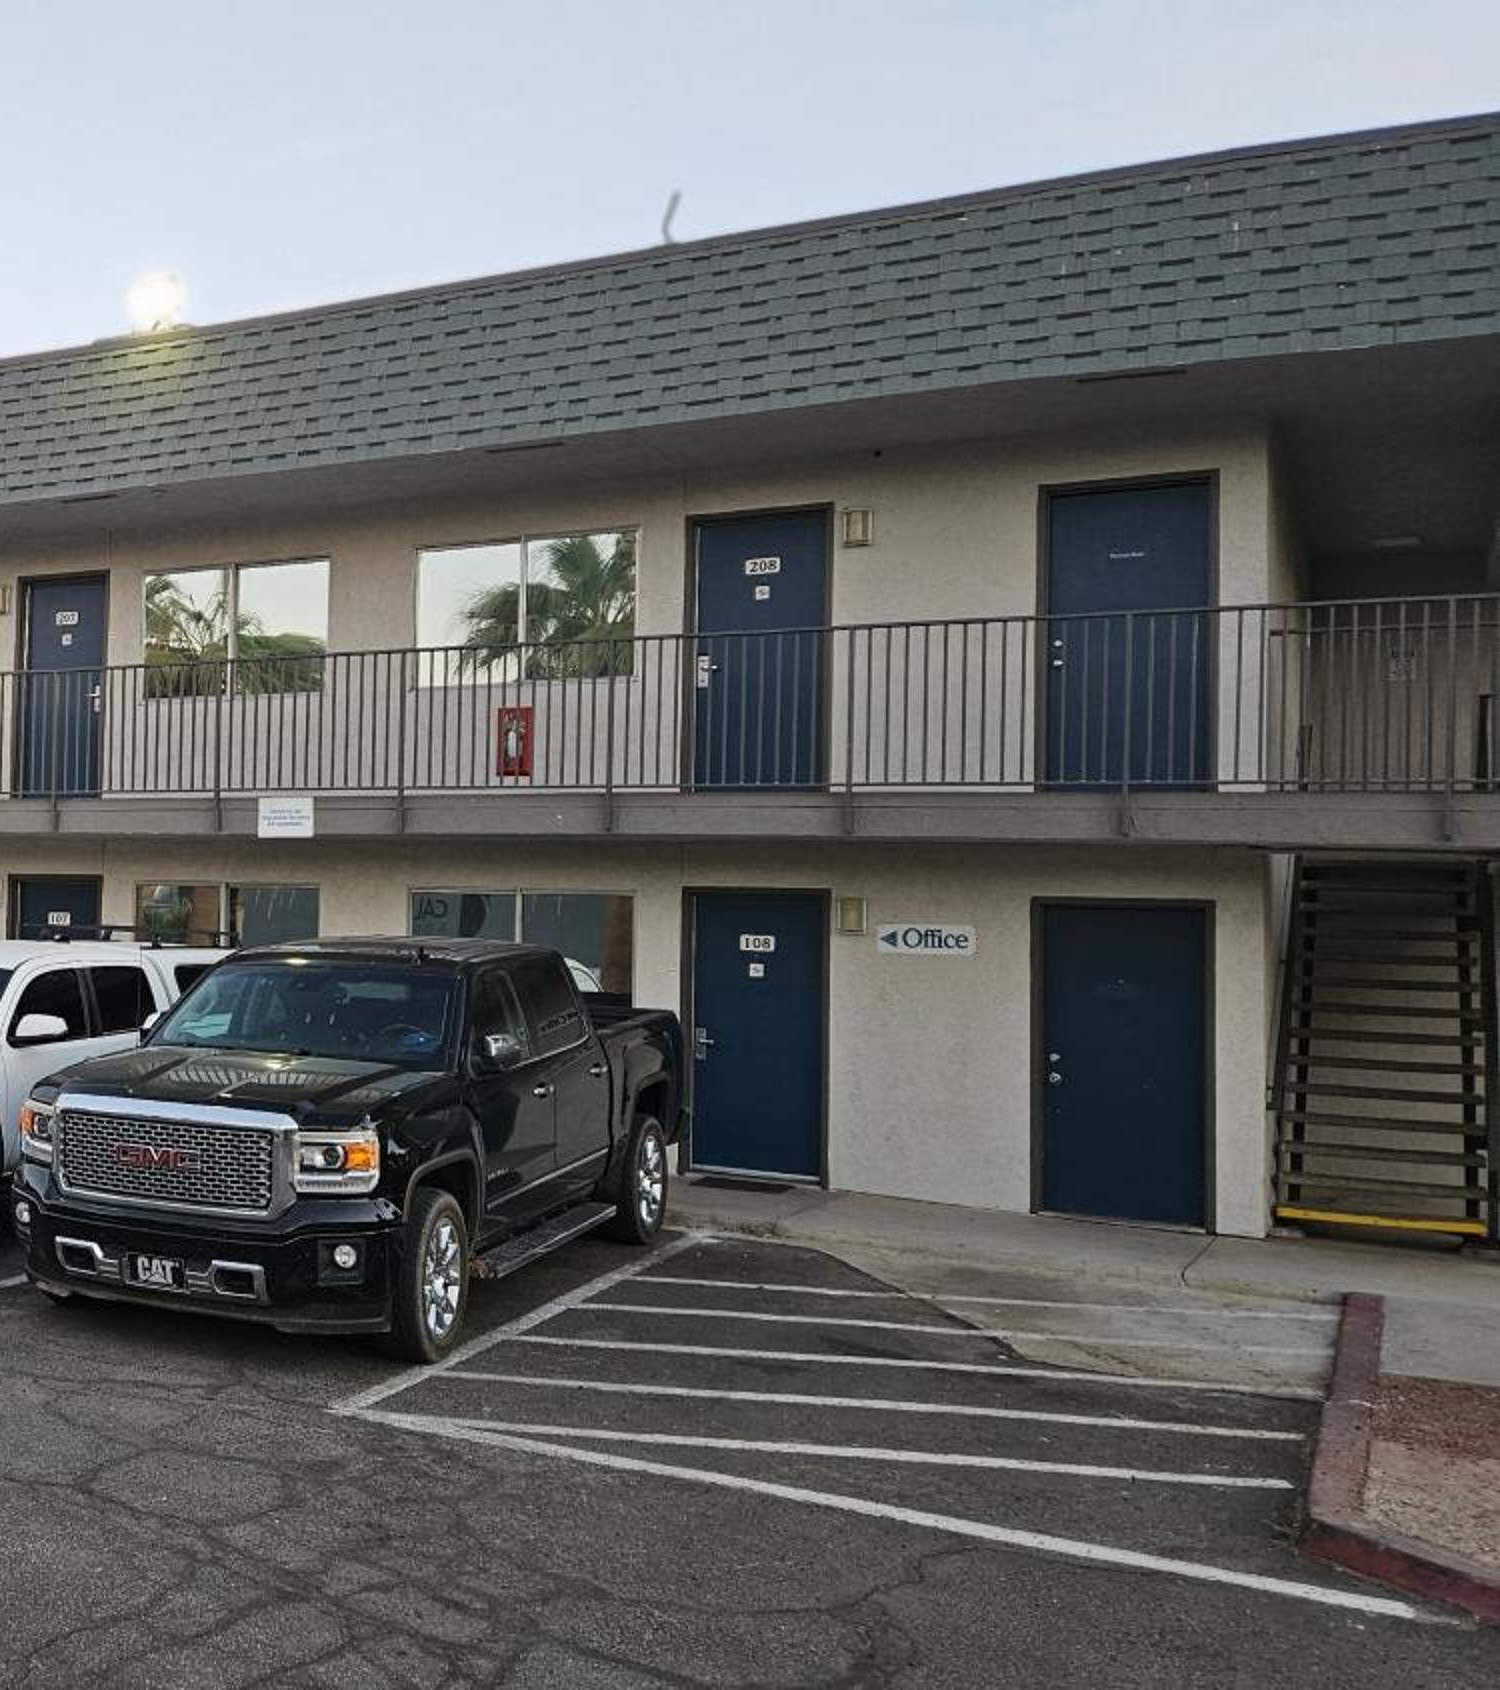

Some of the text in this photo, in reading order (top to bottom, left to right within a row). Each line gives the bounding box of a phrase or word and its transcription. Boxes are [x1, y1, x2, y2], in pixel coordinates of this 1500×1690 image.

[748, 558, 779, 573] 208
[57, 612, 79, 625] 207
[50, 914, 69, 924] 107
[744, 936, 772, 950] 108
[901, 927, 969, 949] Office
[115, 1142, 201, 1174] GMC
[136, 1256, 176, 1285] CAT
